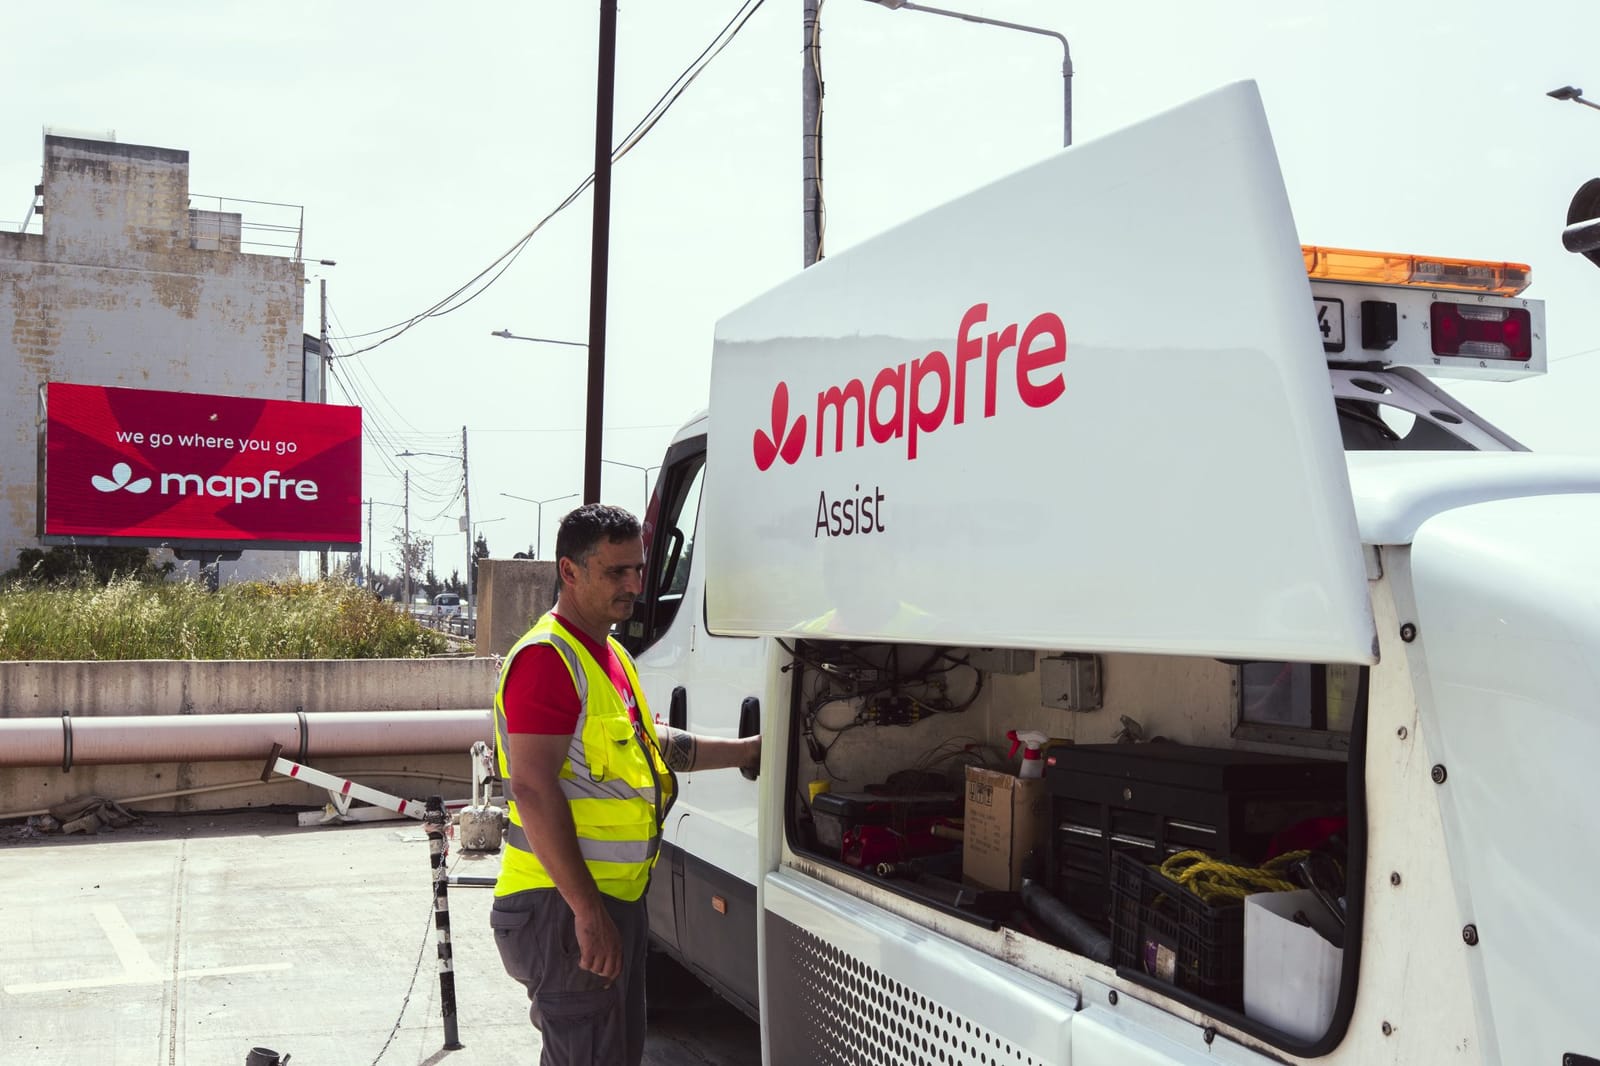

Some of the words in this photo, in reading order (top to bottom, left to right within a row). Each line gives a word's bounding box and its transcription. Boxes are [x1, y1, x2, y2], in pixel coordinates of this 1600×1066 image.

[815, 303, 1067, 461] mapfre
[116, 431, 144, 444] we
[149, 433, 174, 449] go
[178, 433, 234, 449] where
[238, 438, 270, 453] you
[275, 441, 297, 456] go
[160, 470, 319, 504] mapfre
[814, 484, 885, 538] Assist
